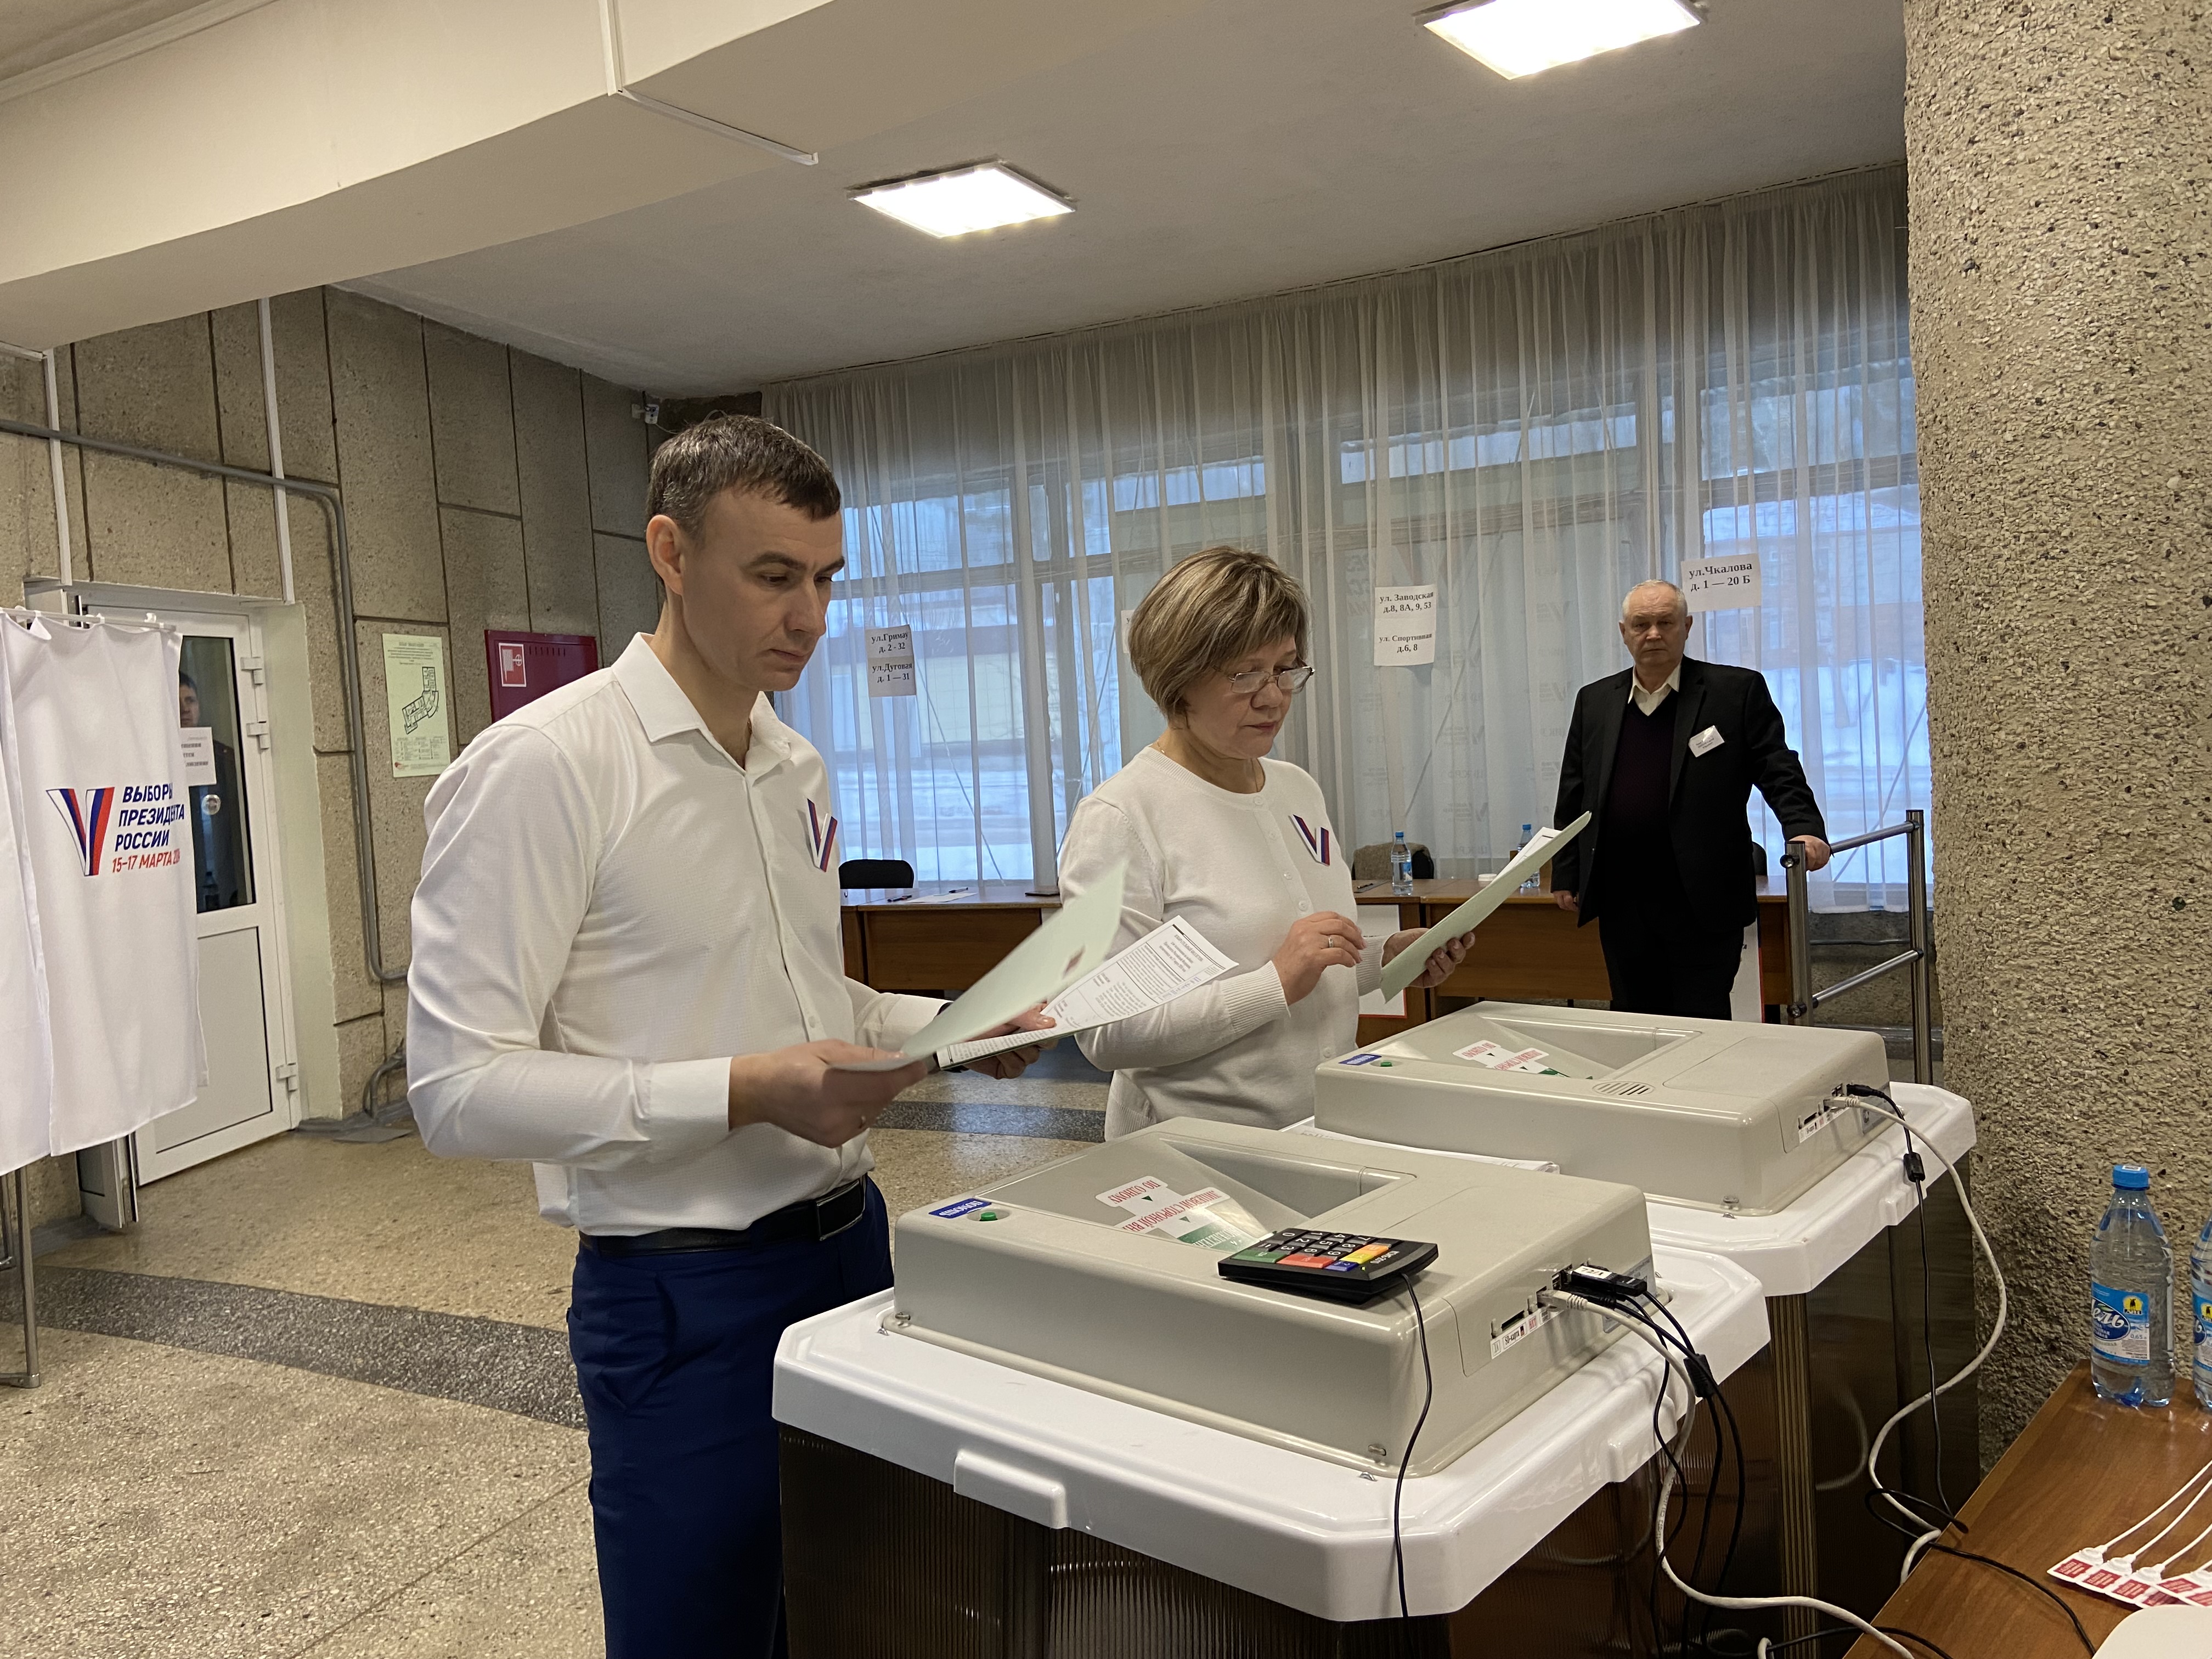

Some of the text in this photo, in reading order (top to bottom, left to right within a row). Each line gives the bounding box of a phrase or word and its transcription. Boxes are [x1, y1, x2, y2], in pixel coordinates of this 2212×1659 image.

[1689, 563, 1752, 579] ул.Чкалова
[1691, 584, 1700, 592] д.
[1703, 580, 1709, 589] 1
[1727, 576, 1739, 585] 20
[1742, 575, 1751, 584] Б
[1394, 592, 1434, 601] Заводская
[1383, 605, 1398, 613] д.8,
[1400, 604, 1413, 612] 8А,
[871, 631, 909, 644] ул.Гримау
[1392, 633, 1432, 642] Спортивная
[1397, 645, 1411, 653] д.6,
[872, 663, 912, 673] ул.Дуговая
[115, 829, 170, 852] РОССИИ
[139, 851, 172, 870] МАРТА
[1107, 1180, 1161, 1204] ПО ОДНОМУ
[939, 1200, 984, 1216] ПОМОЩЬ
[1180, 1190, 1220, 1211] ЛИЦЕВОЙ
[1138, 1204, 1186, 1228] СТОРОНОЙ
